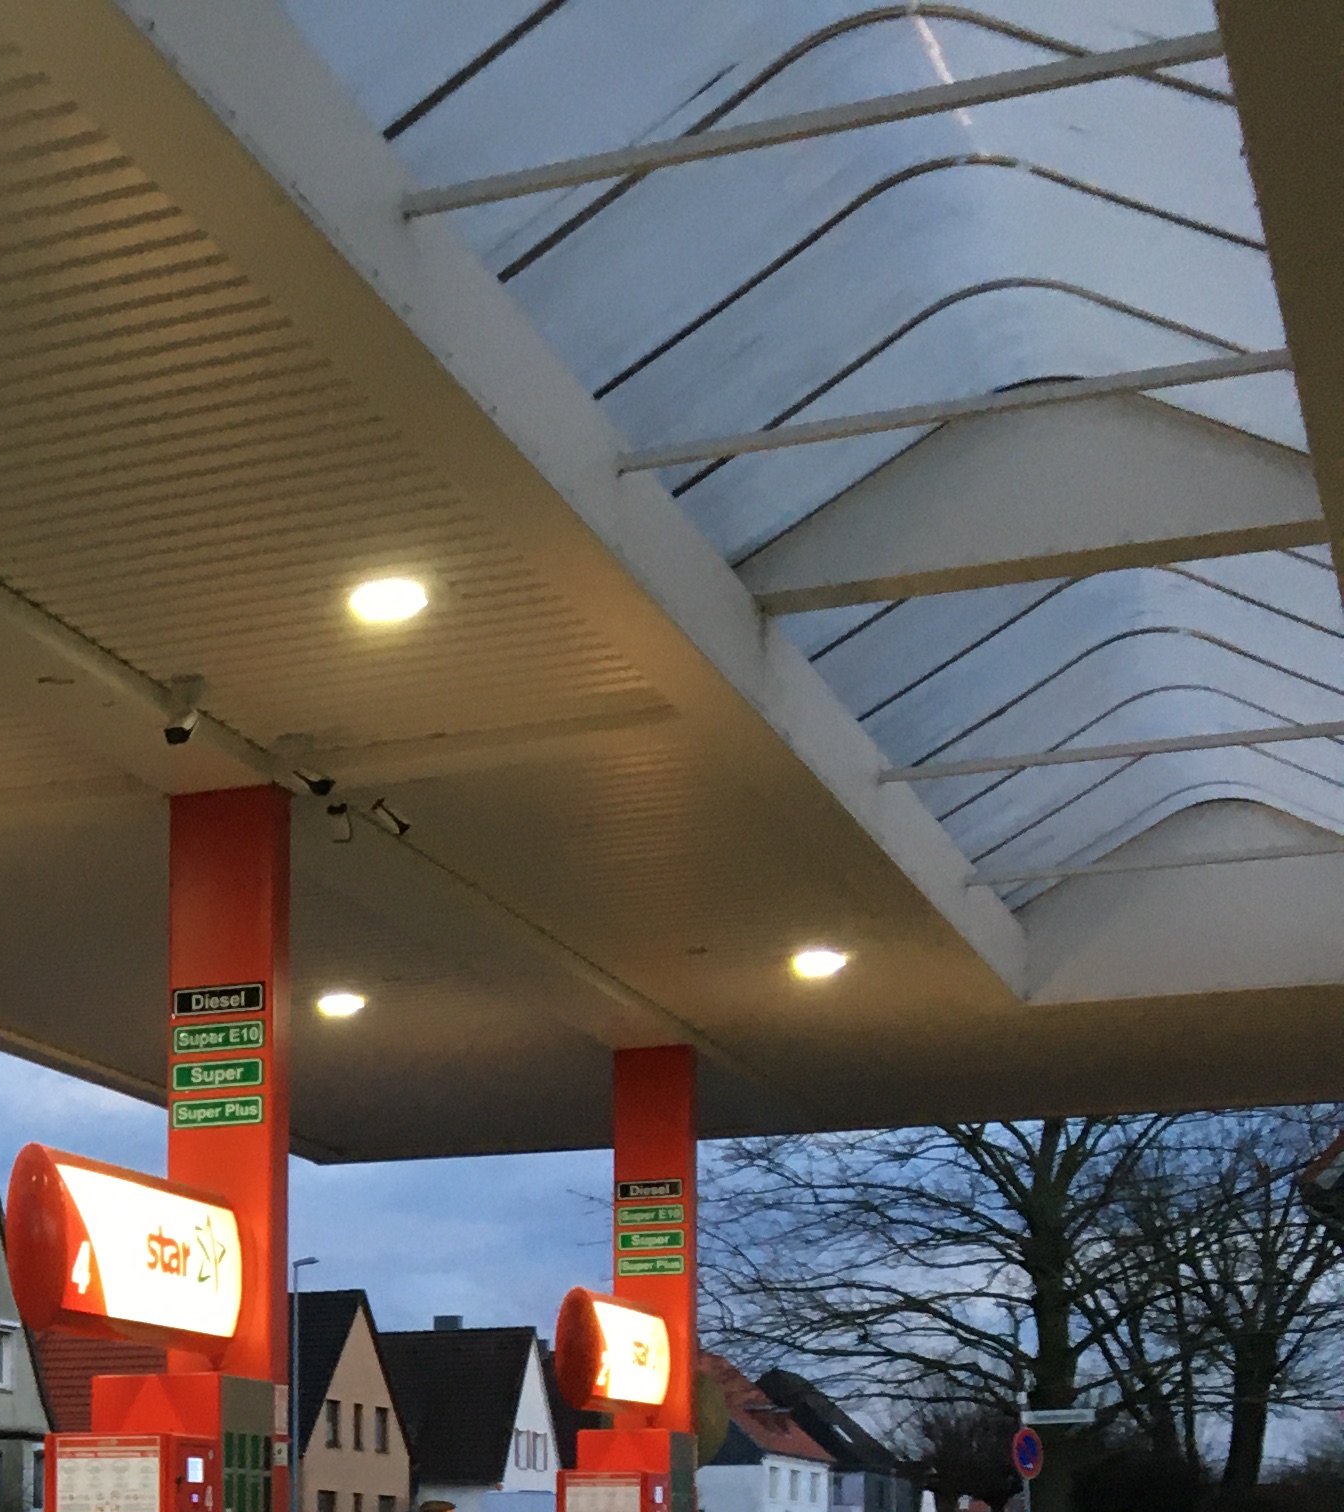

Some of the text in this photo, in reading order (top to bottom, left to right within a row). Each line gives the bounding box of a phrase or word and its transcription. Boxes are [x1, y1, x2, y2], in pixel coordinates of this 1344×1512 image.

[191, 991, 246, 1011] Diesel
[178, 1025, 259, 1052] Super E10
[189, 1065, 244, 1086] Super
[177, 1101, 258, 1123] Super Plus
[629, 1183, 670, 1196] Diesel
[621, 1211, 656, 1224] Super
[146, 1225, 192, 1278] star
[631, 1234, 671, 1248] Super
[71, 1240, 92, 1295] 4
